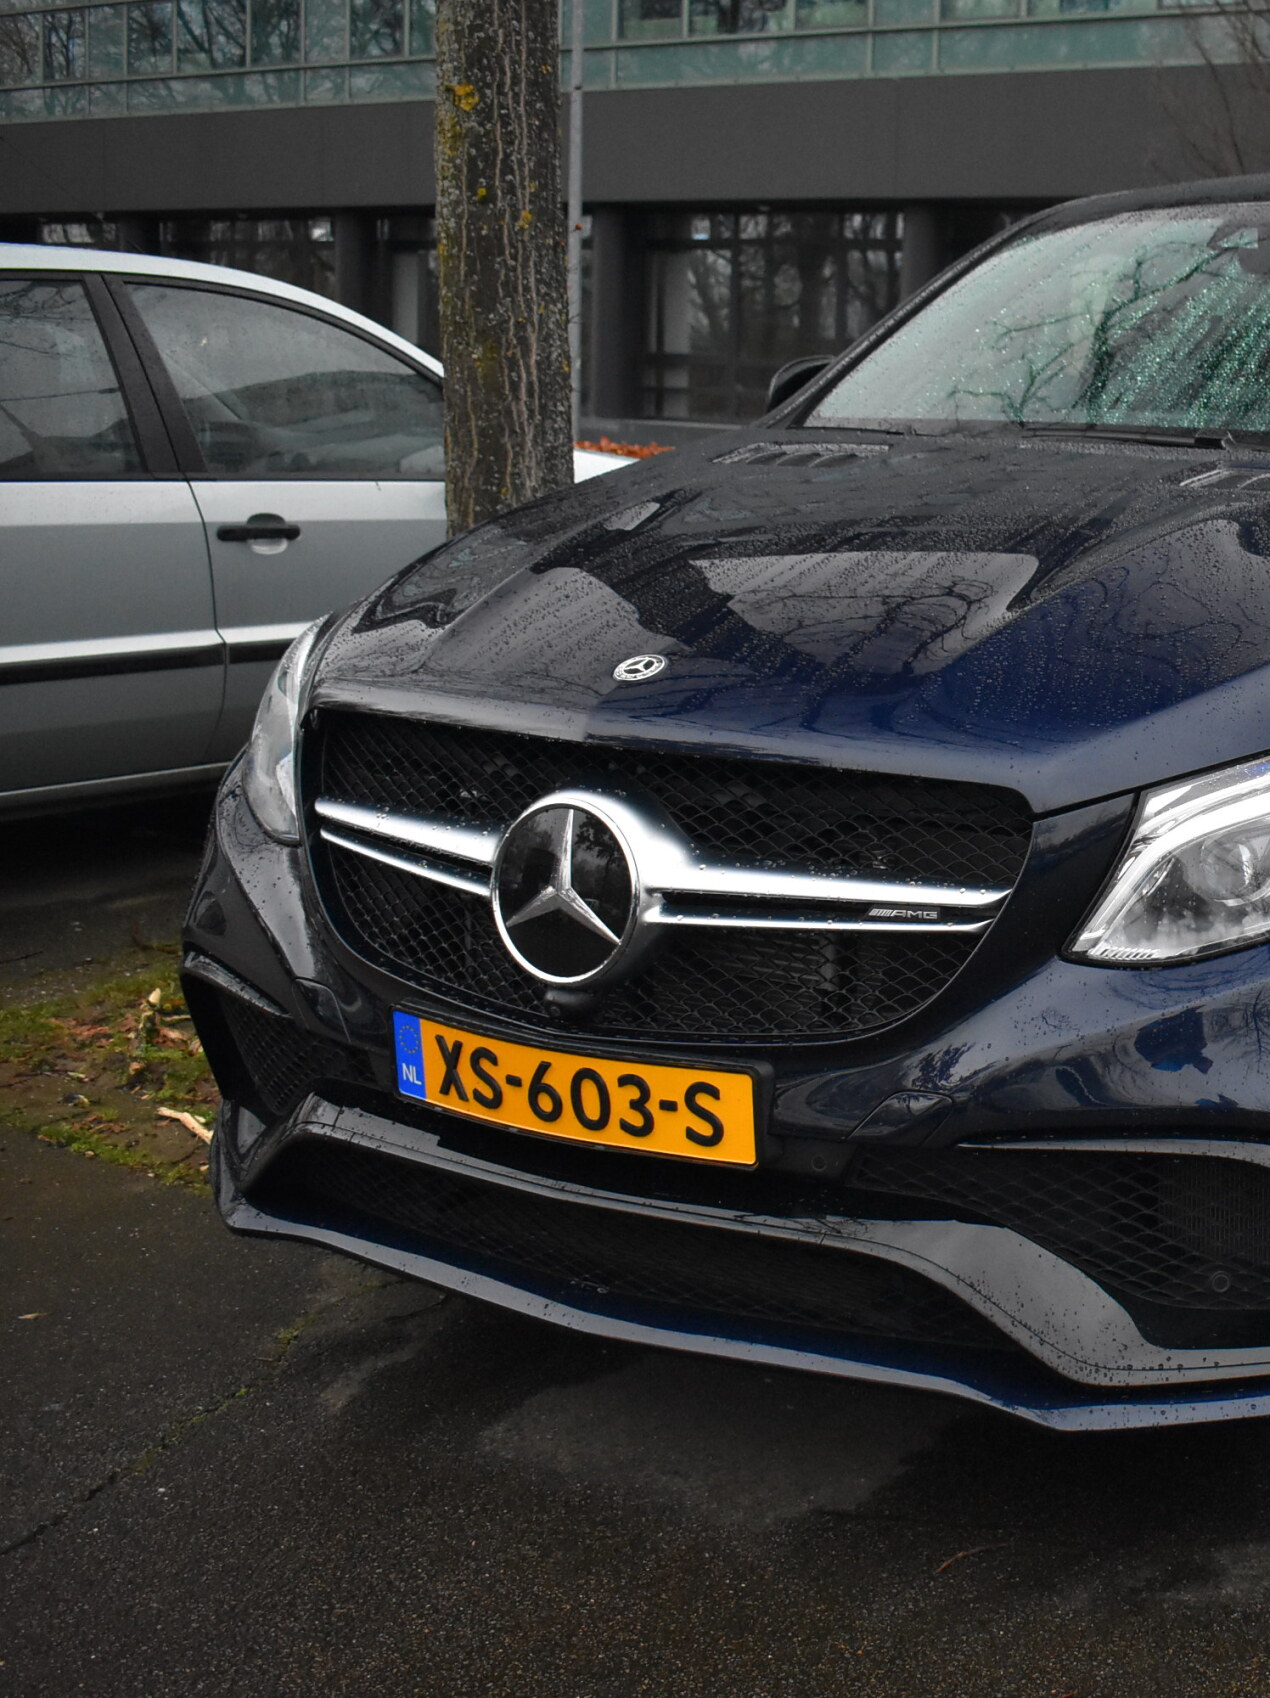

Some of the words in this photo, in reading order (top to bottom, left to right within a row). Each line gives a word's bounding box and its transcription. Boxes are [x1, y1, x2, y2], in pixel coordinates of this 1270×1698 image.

[890, 909, 938, 919] AMG
[402, 1063, 422, 1085] NL
[435, 1034, 725, 1147] XS-603-S
